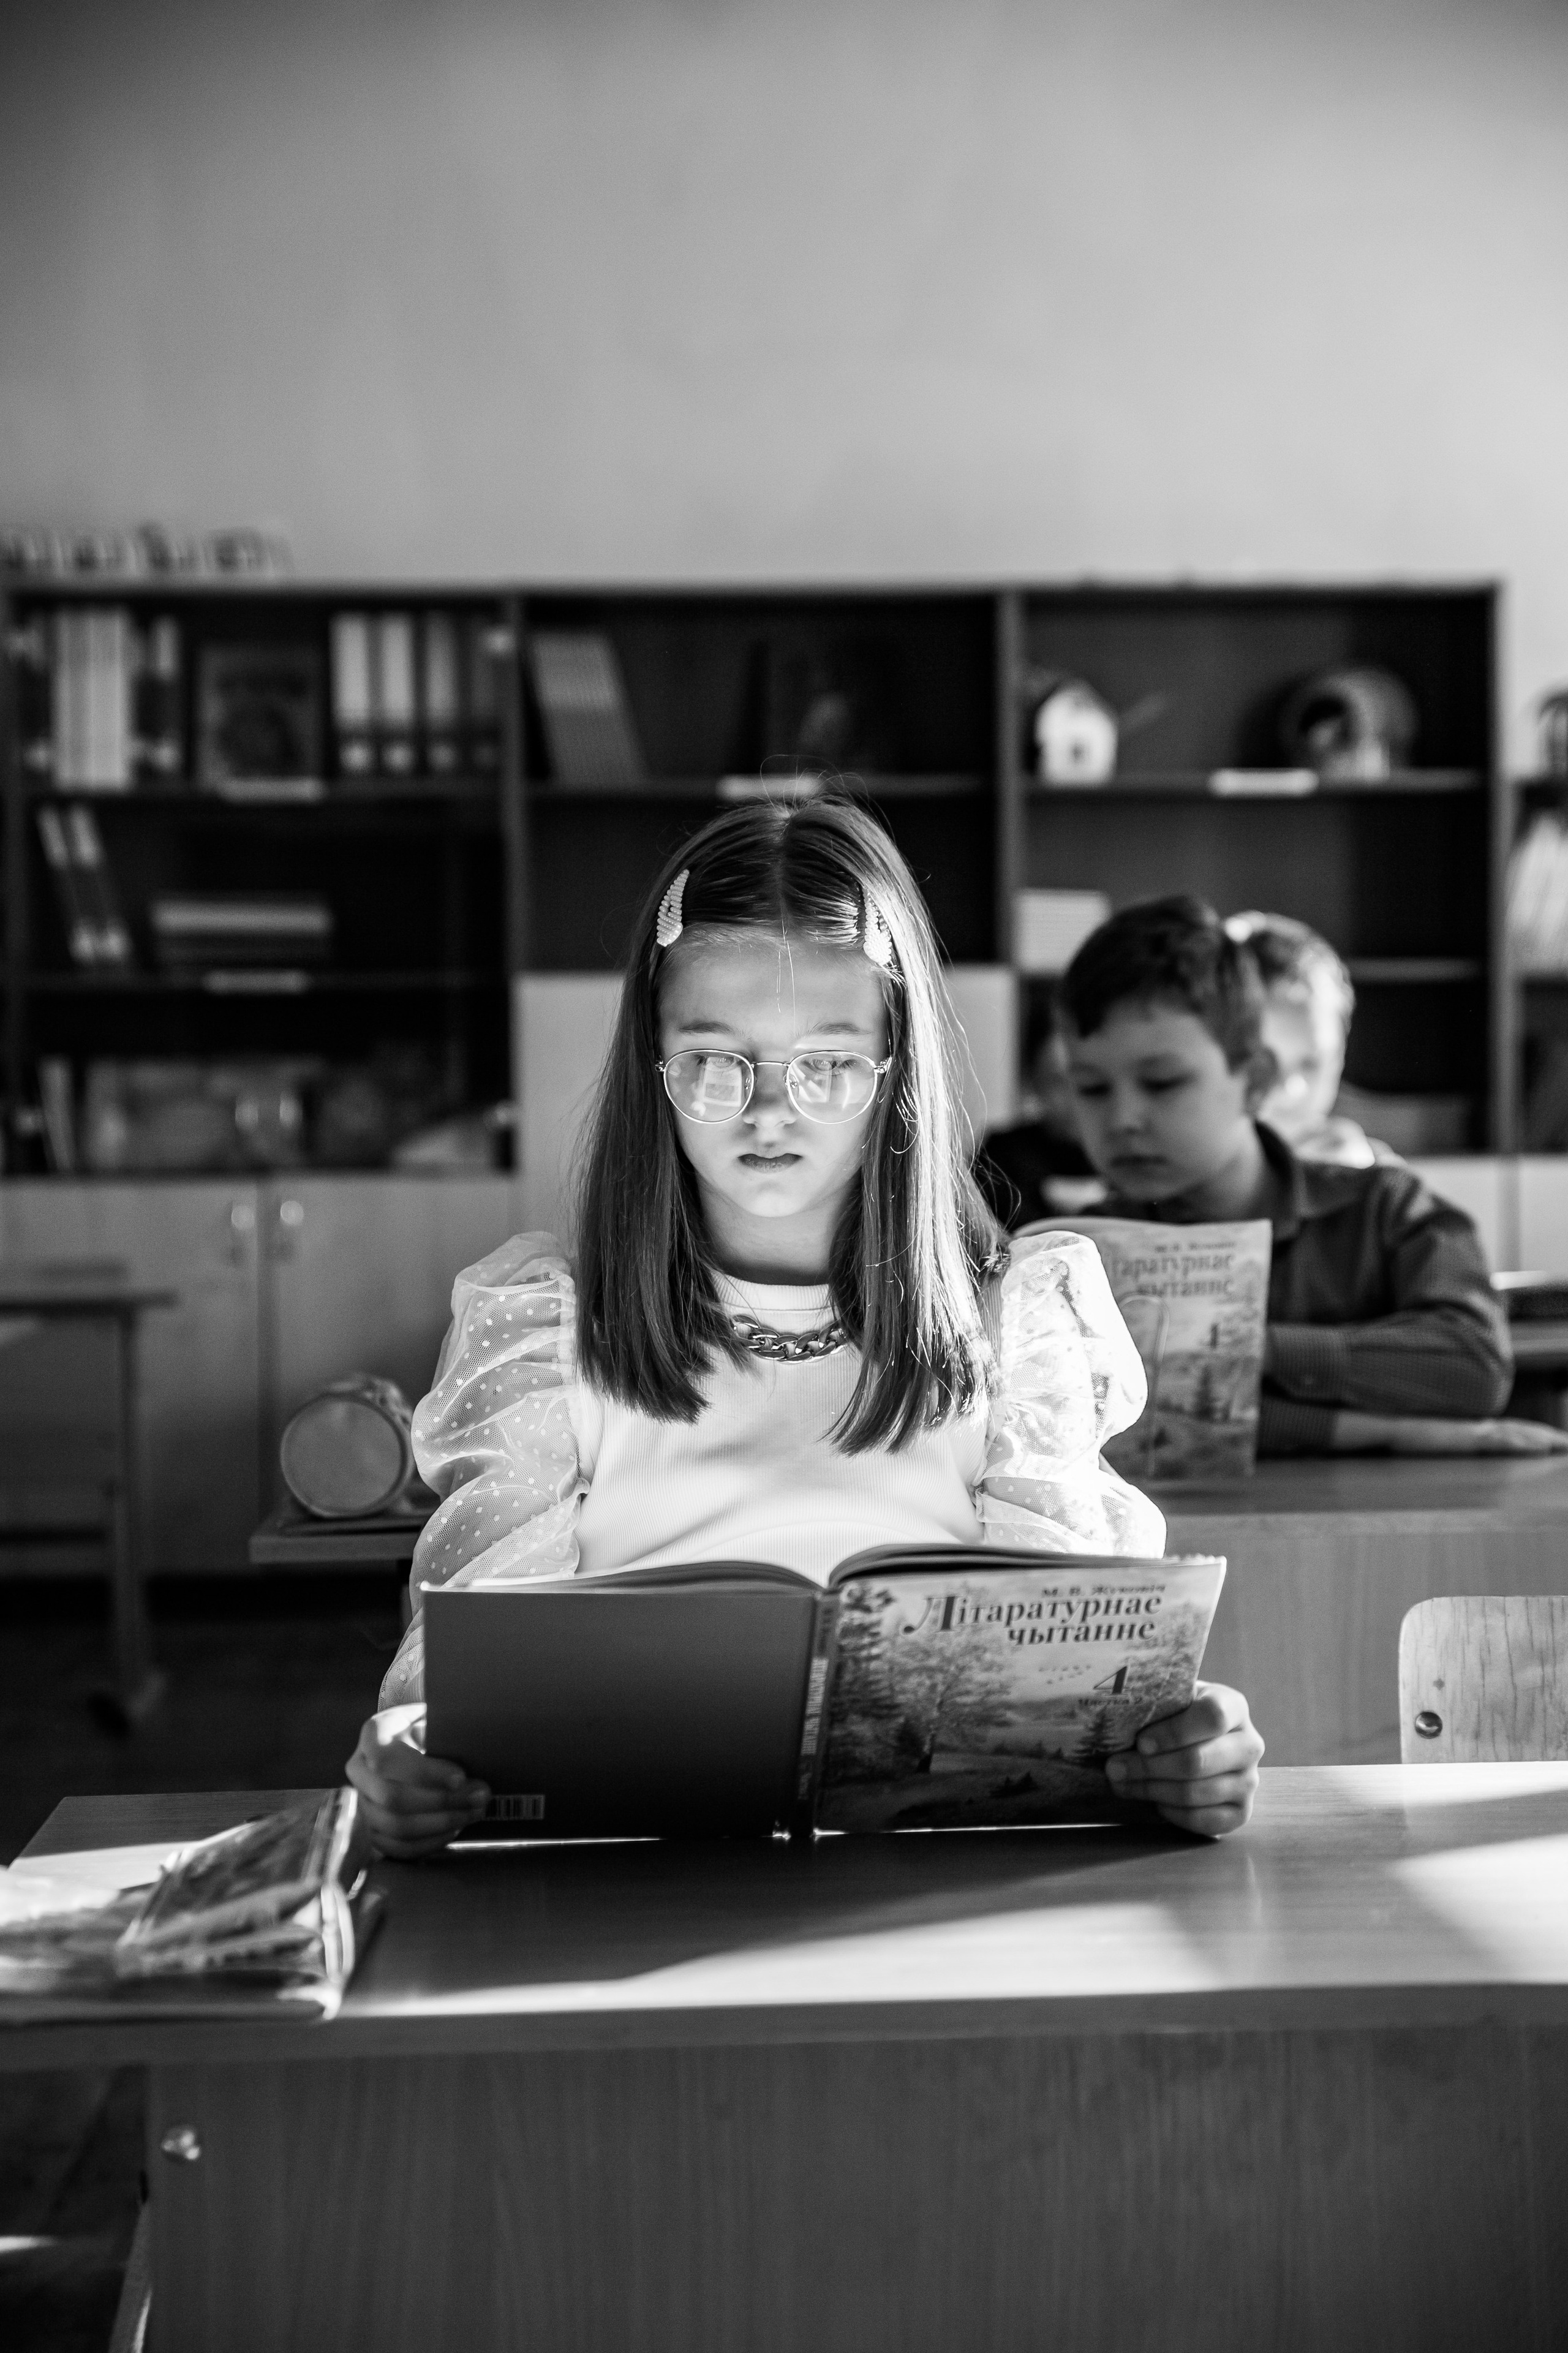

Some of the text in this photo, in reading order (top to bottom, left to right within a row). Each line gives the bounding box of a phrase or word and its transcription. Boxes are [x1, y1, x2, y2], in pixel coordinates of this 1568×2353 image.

[903, 1594, 1161, 1634] Літаратурнае
[1008, 1620, 1156, 1645] чытанне
[1093, 1665, 1130, 1695] 4
